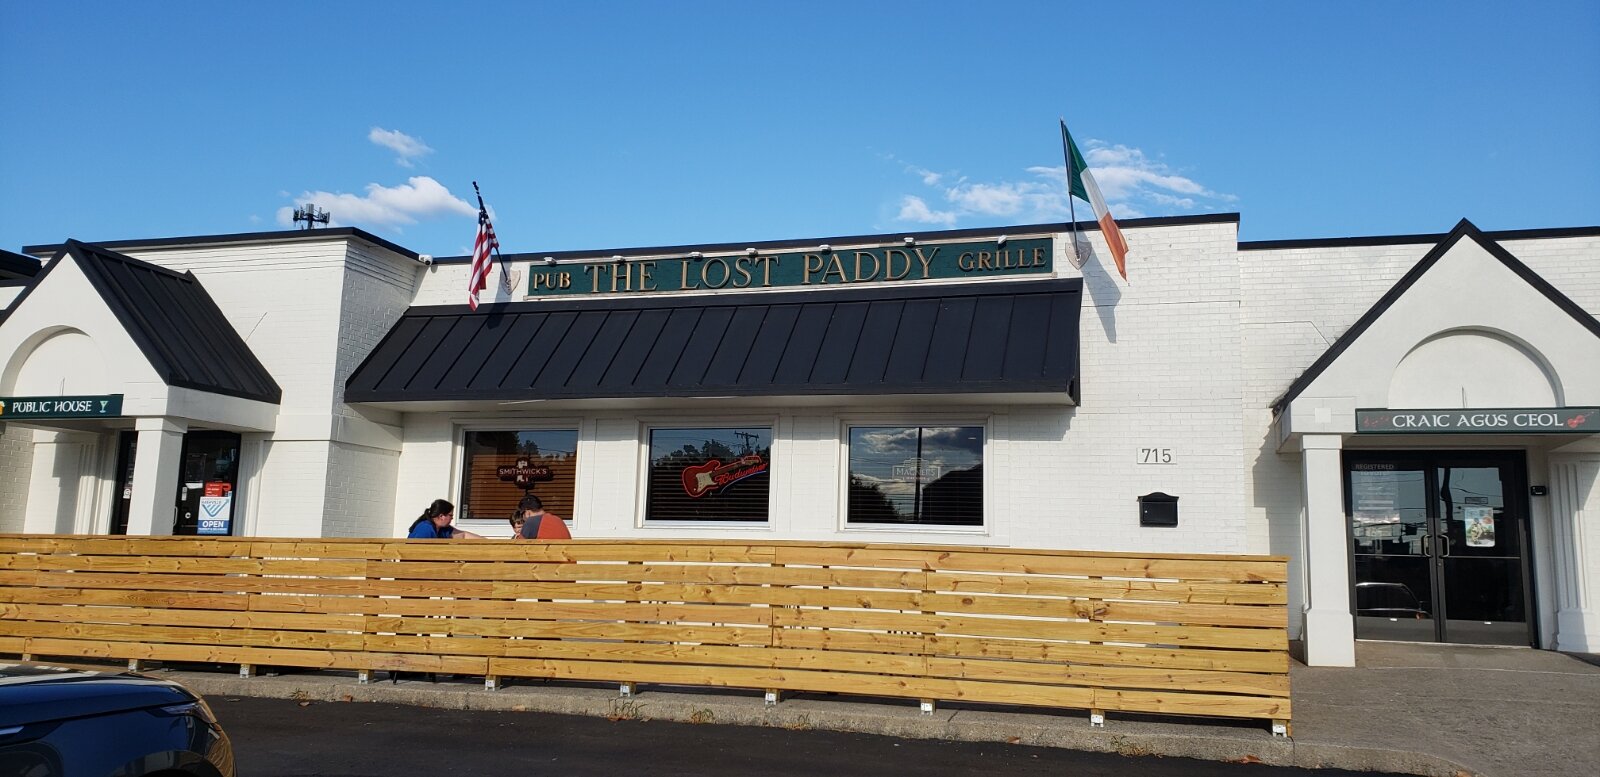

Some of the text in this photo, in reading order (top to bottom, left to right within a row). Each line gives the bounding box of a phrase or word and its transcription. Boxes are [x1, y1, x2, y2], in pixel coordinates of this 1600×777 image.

[533, 246, 1047, 293] PUB THE LOST PADDY GRILLE
[12, 400, 93, 413] PUBLIC HOUSE
[1392, 413, 1564, 428] CRAIC AGUS CEOL
[1141, 448, 1172, 463] 715
[714, 462, 769, 486] Budweiser
[202, 520, 224, 528] OPEN
